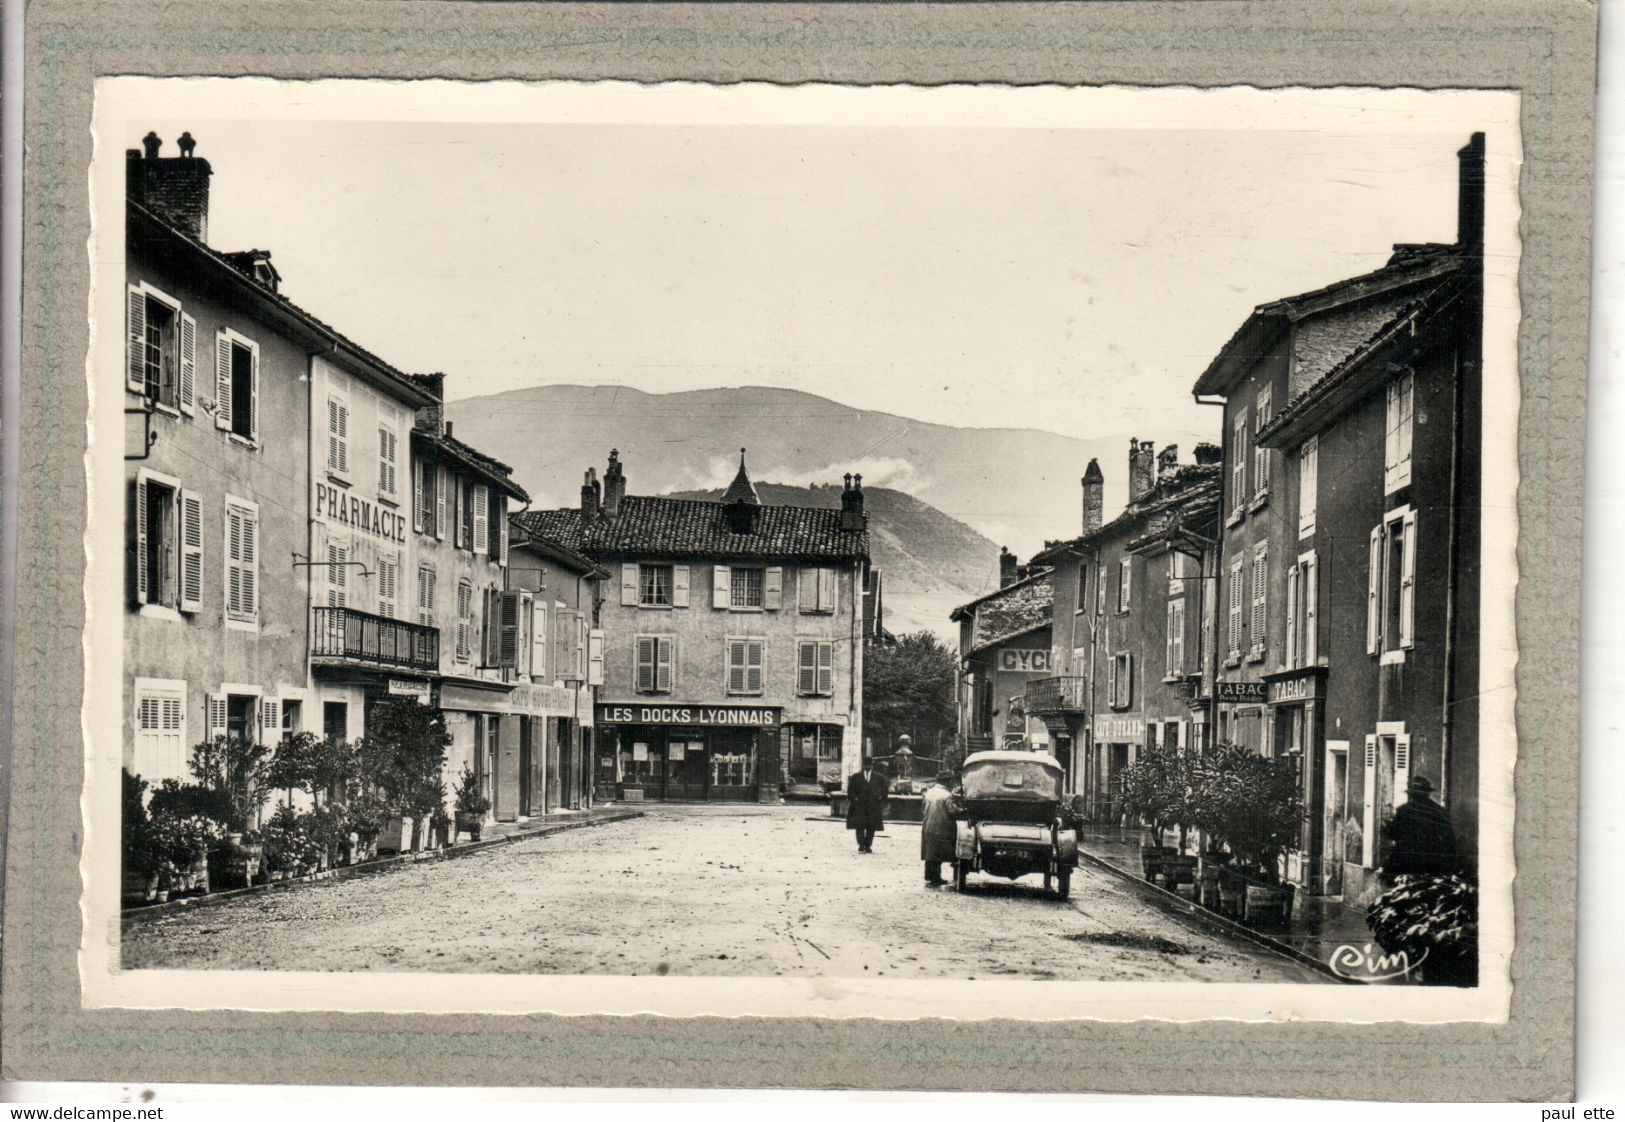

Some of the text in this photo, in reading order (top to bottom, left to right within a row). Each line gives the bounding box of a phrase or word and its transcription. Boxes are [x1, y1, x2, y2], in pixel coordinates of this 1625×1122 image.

[316, 482, 406, 543] PHARMACIE
[1215, 683, 1267, 695] TABAC
[1274, 678, 1307, 700] TABAC
[604, 707, 774, 724] LES DOCKS LYONNAIS
